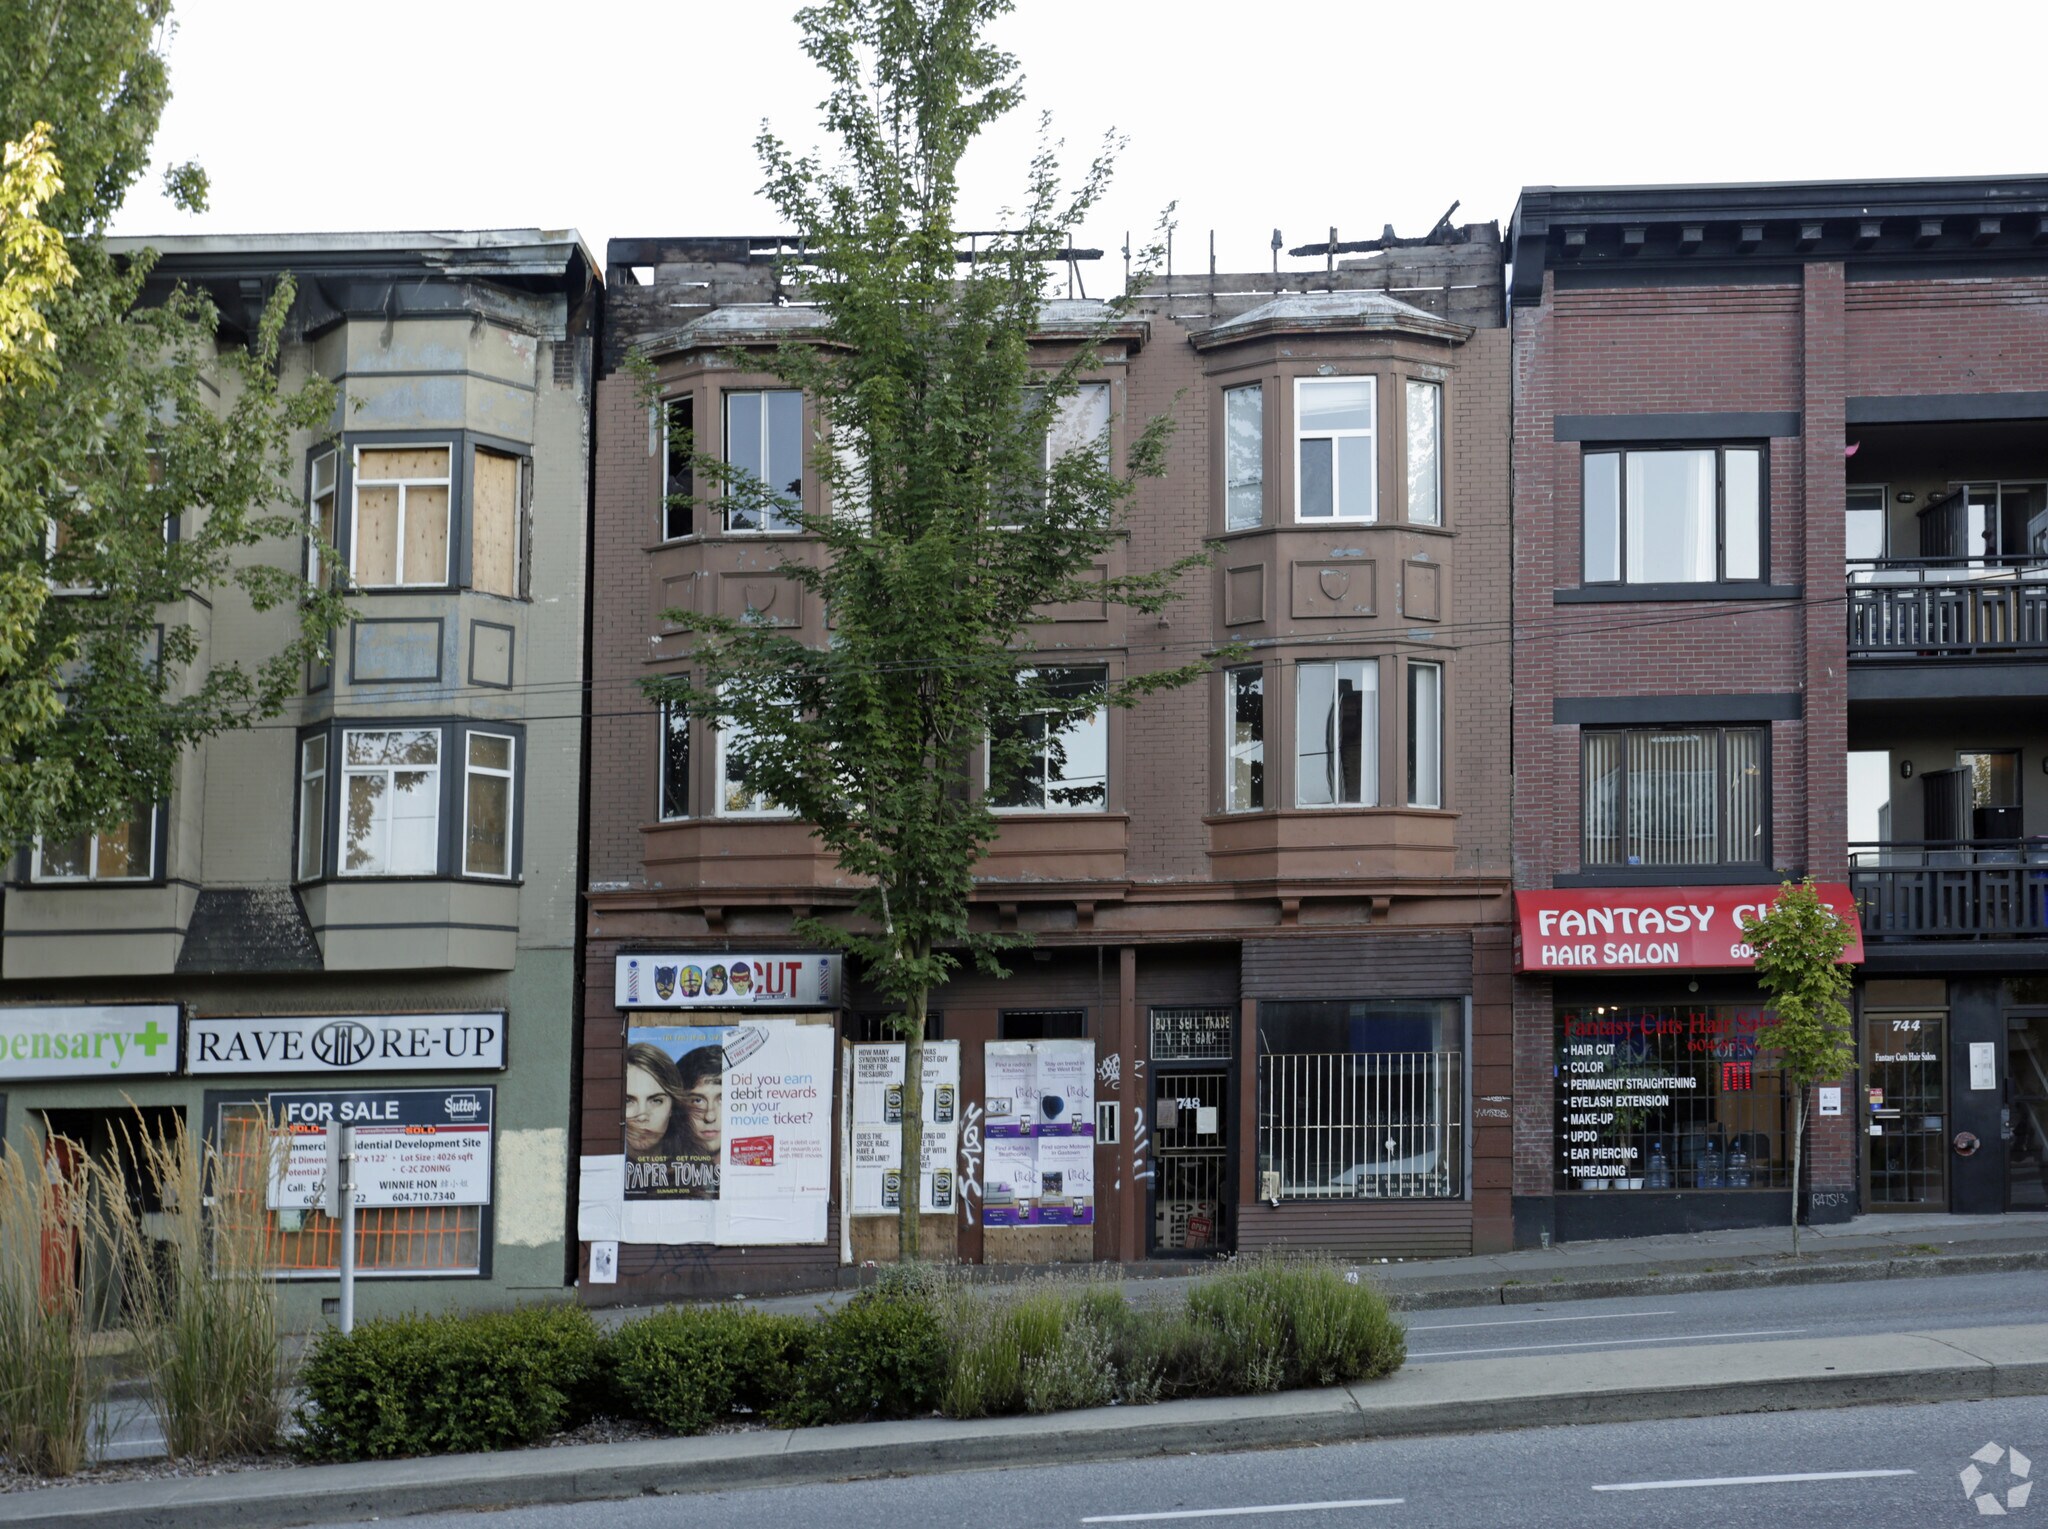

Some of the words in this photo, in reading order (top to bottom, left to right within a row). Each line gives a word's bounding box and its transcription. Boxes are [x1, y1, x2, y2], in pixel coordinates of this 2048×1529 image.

[1538, 905, 1715, 936] FANTASY
[1541, 944, 1597, 966] HAIR
[1603, 942, 1680, 965] SALON
[1204, 1016, 1230, 1029] TRADE
[1564, 1015, 1635, 1040] Fantasy
[1641, 1014, 1683, 1034] Cuts
[1689, 1013, 1732, 1034] Hair
[1893, 1020, 1920, 1031] 744
[197, 1031, 304, 1061] RAVE
[379, 1027, 495, 1058] RE-UP
[1570, 1045, 1593, 1056] HAIR
[1596, 1044, 1615, 1055] CUT
[1875, 1053, 1895, 1063] Fantasy
[1896, 1052, 1907, 1061] Cuts
[1908, 1052, 1921, 1061] Hair
[1921, 1052, 1936, 1061] Salon
[1570, 1062, 1604, 1073] COLOR
[731, 1073, 752, 1085] Did
[757, 1075, 780, 1088] you
[784, 1074, 812, 1084] earn
[1570, 1079, 1625, 1090] PERMANENT
[1626, 1077, 1696, 1089] STRAIGHTENING
[731, 1087, 762, 1100] debit
[766, 1085, 817, 1098] rewards
[444, 1097, 481, 1113] Sutton
[1176, 1098, 1200, 1110] 748
[1570, 1096, 1613, 1108] EYELASH
[1616, 1095, 1669, 1107] EXTENSION
[287, 1102, 333, 1121] FOR
[340, 1100, 399, 1120] SALE
[731, 1102, 747, 1112] on
[752, 1102, 781, 1115] your
[731, 1113, 769, 1125] movie
[773, 1112, 813, 1124] ticket?
[1570, 1114, 1614, 1125] MAKE-UP
[288, 1125, 319, 1133] SOLD
[405, 1126, 435, 1134] SOLD
[1570, 1131, 1598, 1142] UPDO
[395, 1139, 460, 1150] Development
[462, 1138, 481, 1147] Site
[458, 1153, 473, 1162] sqft
[1570, 1148, 1597, 1160] EAR
[1599, 1147, 1638, 1159] PIERCING
[420, 1165, 451, 1173] ZONING
[1570, 1165, 1626, 1177] THREADING
[625, 1162, 669, 1190] PAPER
[671, 1162, 720, 1187] TOWNS
[287, 1184, 306, 1192] Call:
[380, 1181, 414, 1189] WINNIE
[417, 1180, 437, 1188] HON
[392, 1192, 456, 1201] 604.710.7340
